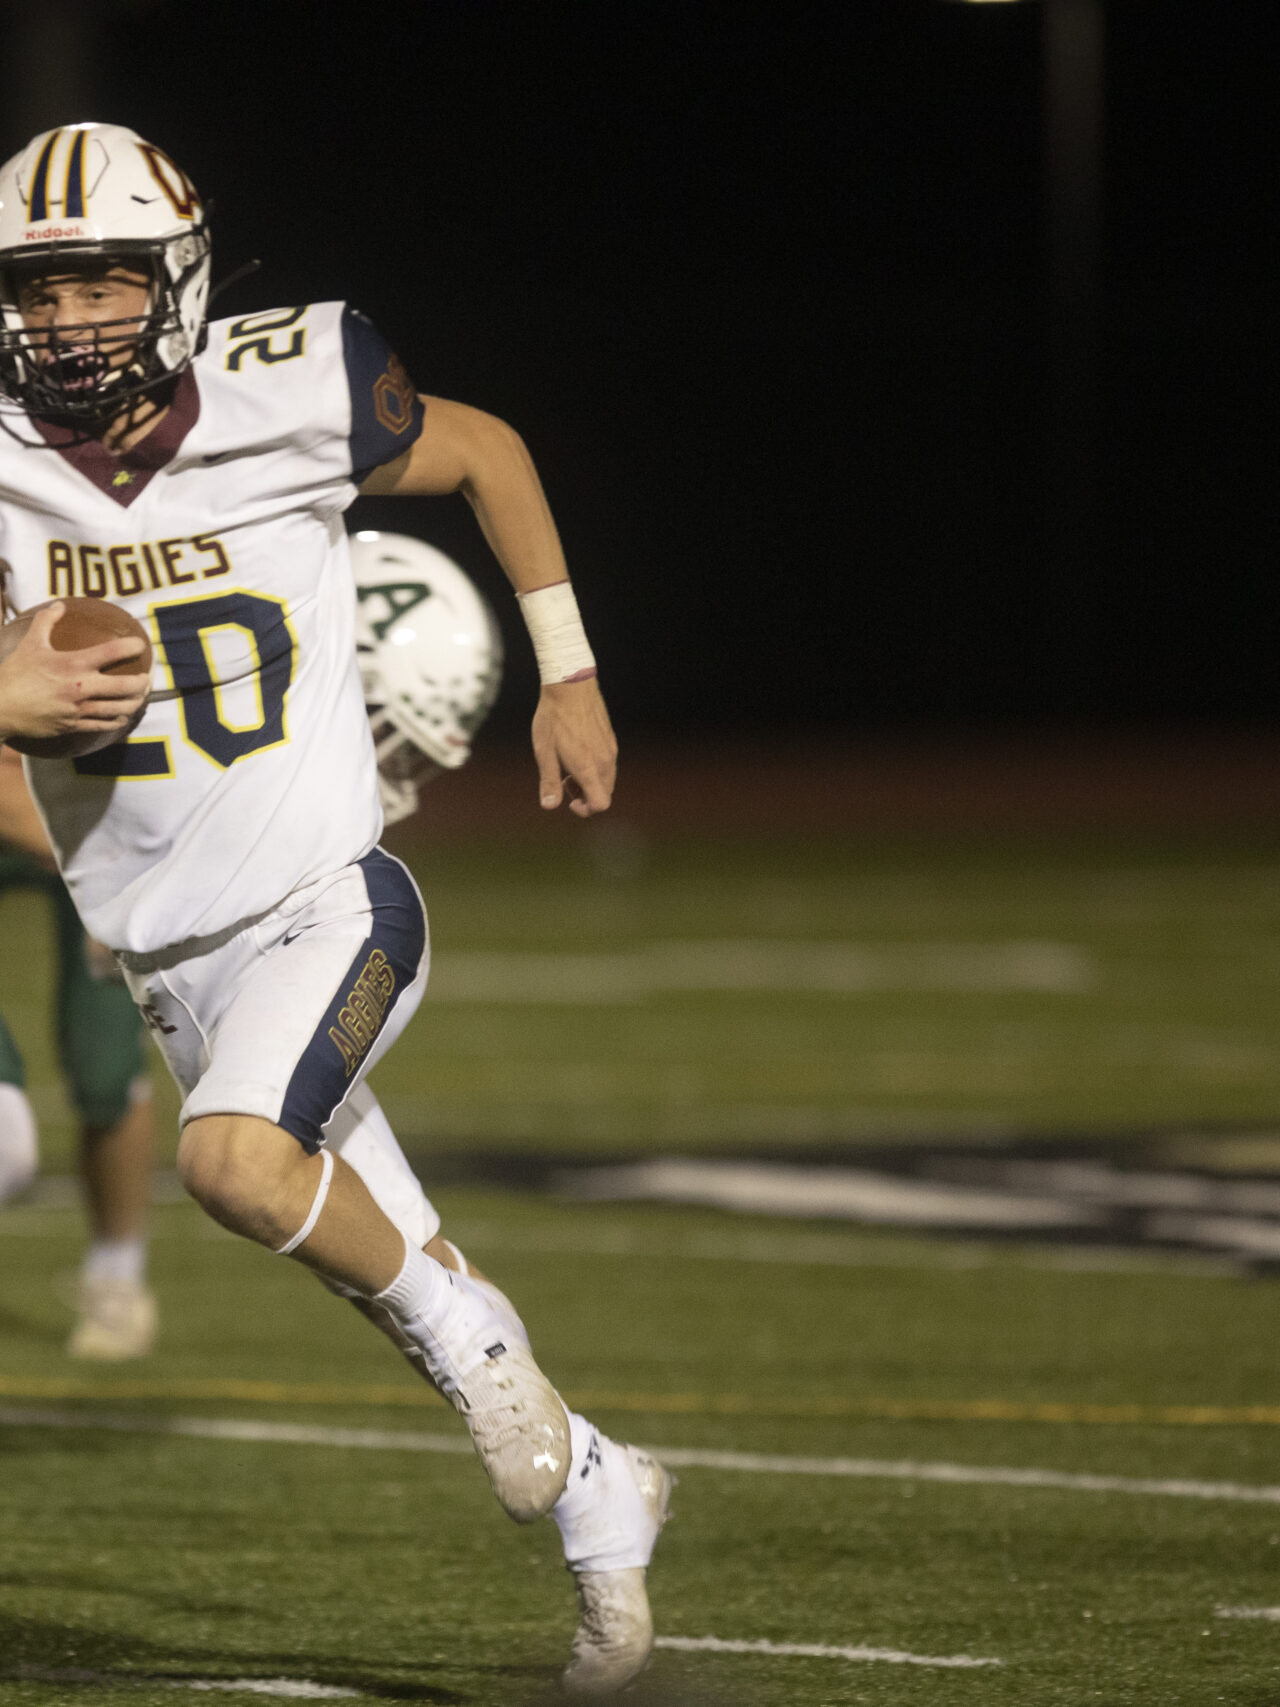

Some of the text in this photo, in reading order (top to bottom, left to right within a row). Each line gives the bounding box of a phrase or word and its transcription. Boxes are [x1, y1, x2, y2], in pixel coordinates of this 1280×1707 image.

[25, 226, 84, 241] Riddel
[224, 304, 307, 373] 20
[47, 538, 231, 600] AGGIES
[328, 948, 396, 1078] AGGIES
